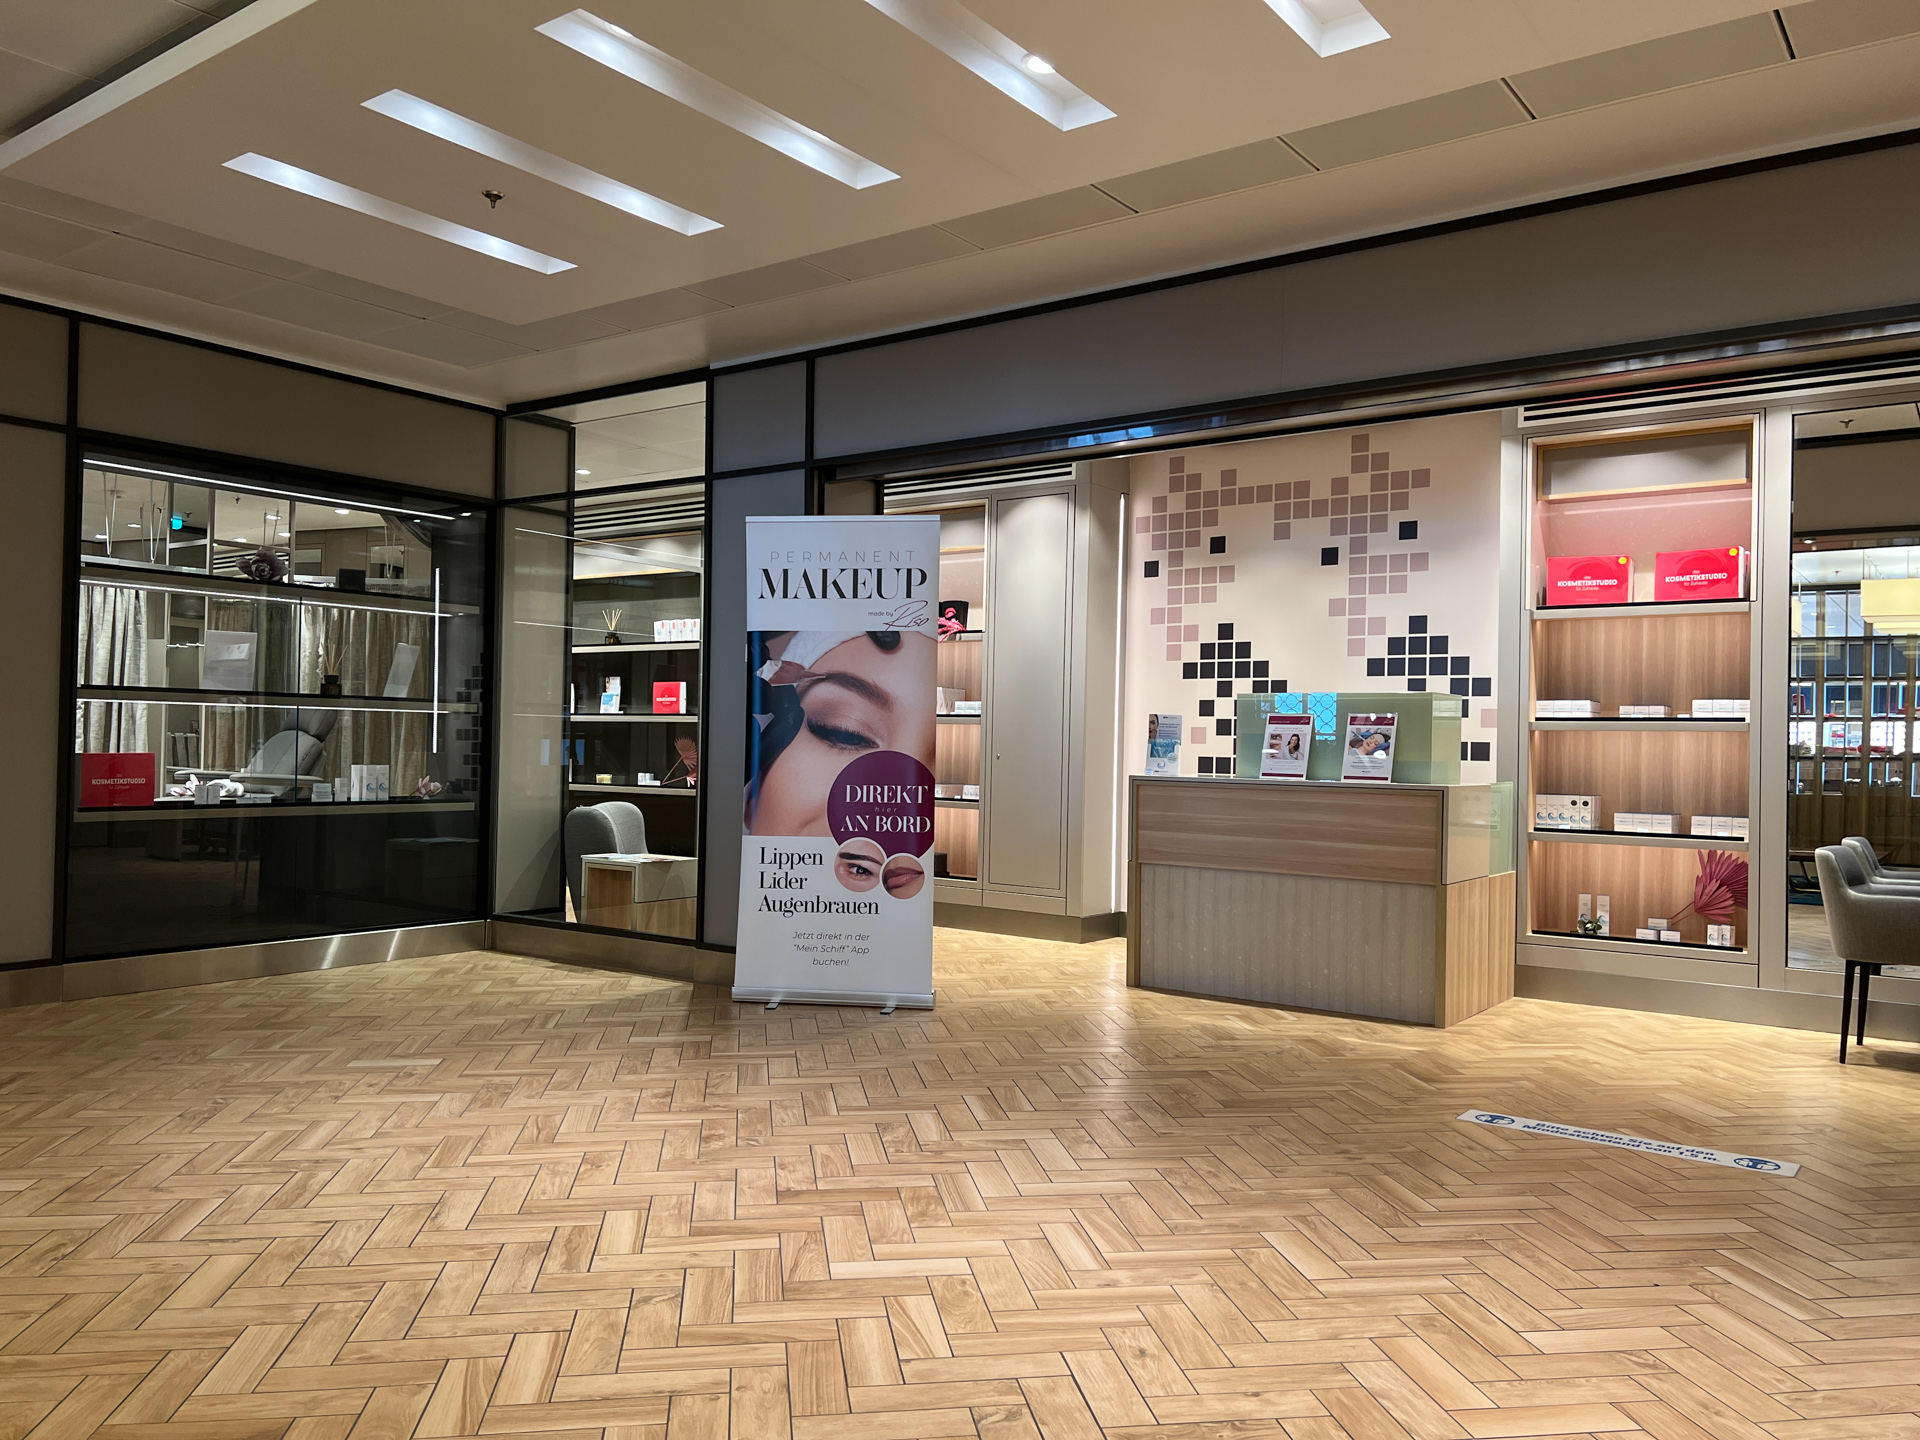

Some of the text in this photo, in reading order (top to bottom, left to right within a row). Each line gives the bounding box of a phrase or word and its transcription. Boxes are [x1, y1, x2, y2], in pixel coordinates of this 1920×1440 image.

[770, 551, 916, 563] PERMANENT
[757, 567, 928, 600] MAKEUP
[1557, 579, 1618, 587] KOSMETIKSTUDIO
[1665, 572, 1728, 583] KOSMETIKSTUDIO
[845, 784, 929, 804] DIREKT
[840, 815, 931, 833] AN BORD
[759, 846, 824, 870] Lippen
[759, 871, 808, 890] Lider
[757, 894, 880, 918] Augenbrauen
[792, 931, 871, 941] Jetzt direkt in der
[850, 946, 870, 955] App
[812, 957, 850, 967] buchen!
[1522, 1125, 1641, 1147] Mindestabstand
[1535, 1123, 1569, 1131] Bitte
[1572, 1129, 1623, 1141] achten
[1627, 1138, 1653, 1146] Sie
[1656, 1144, 1682, 1152] auf
